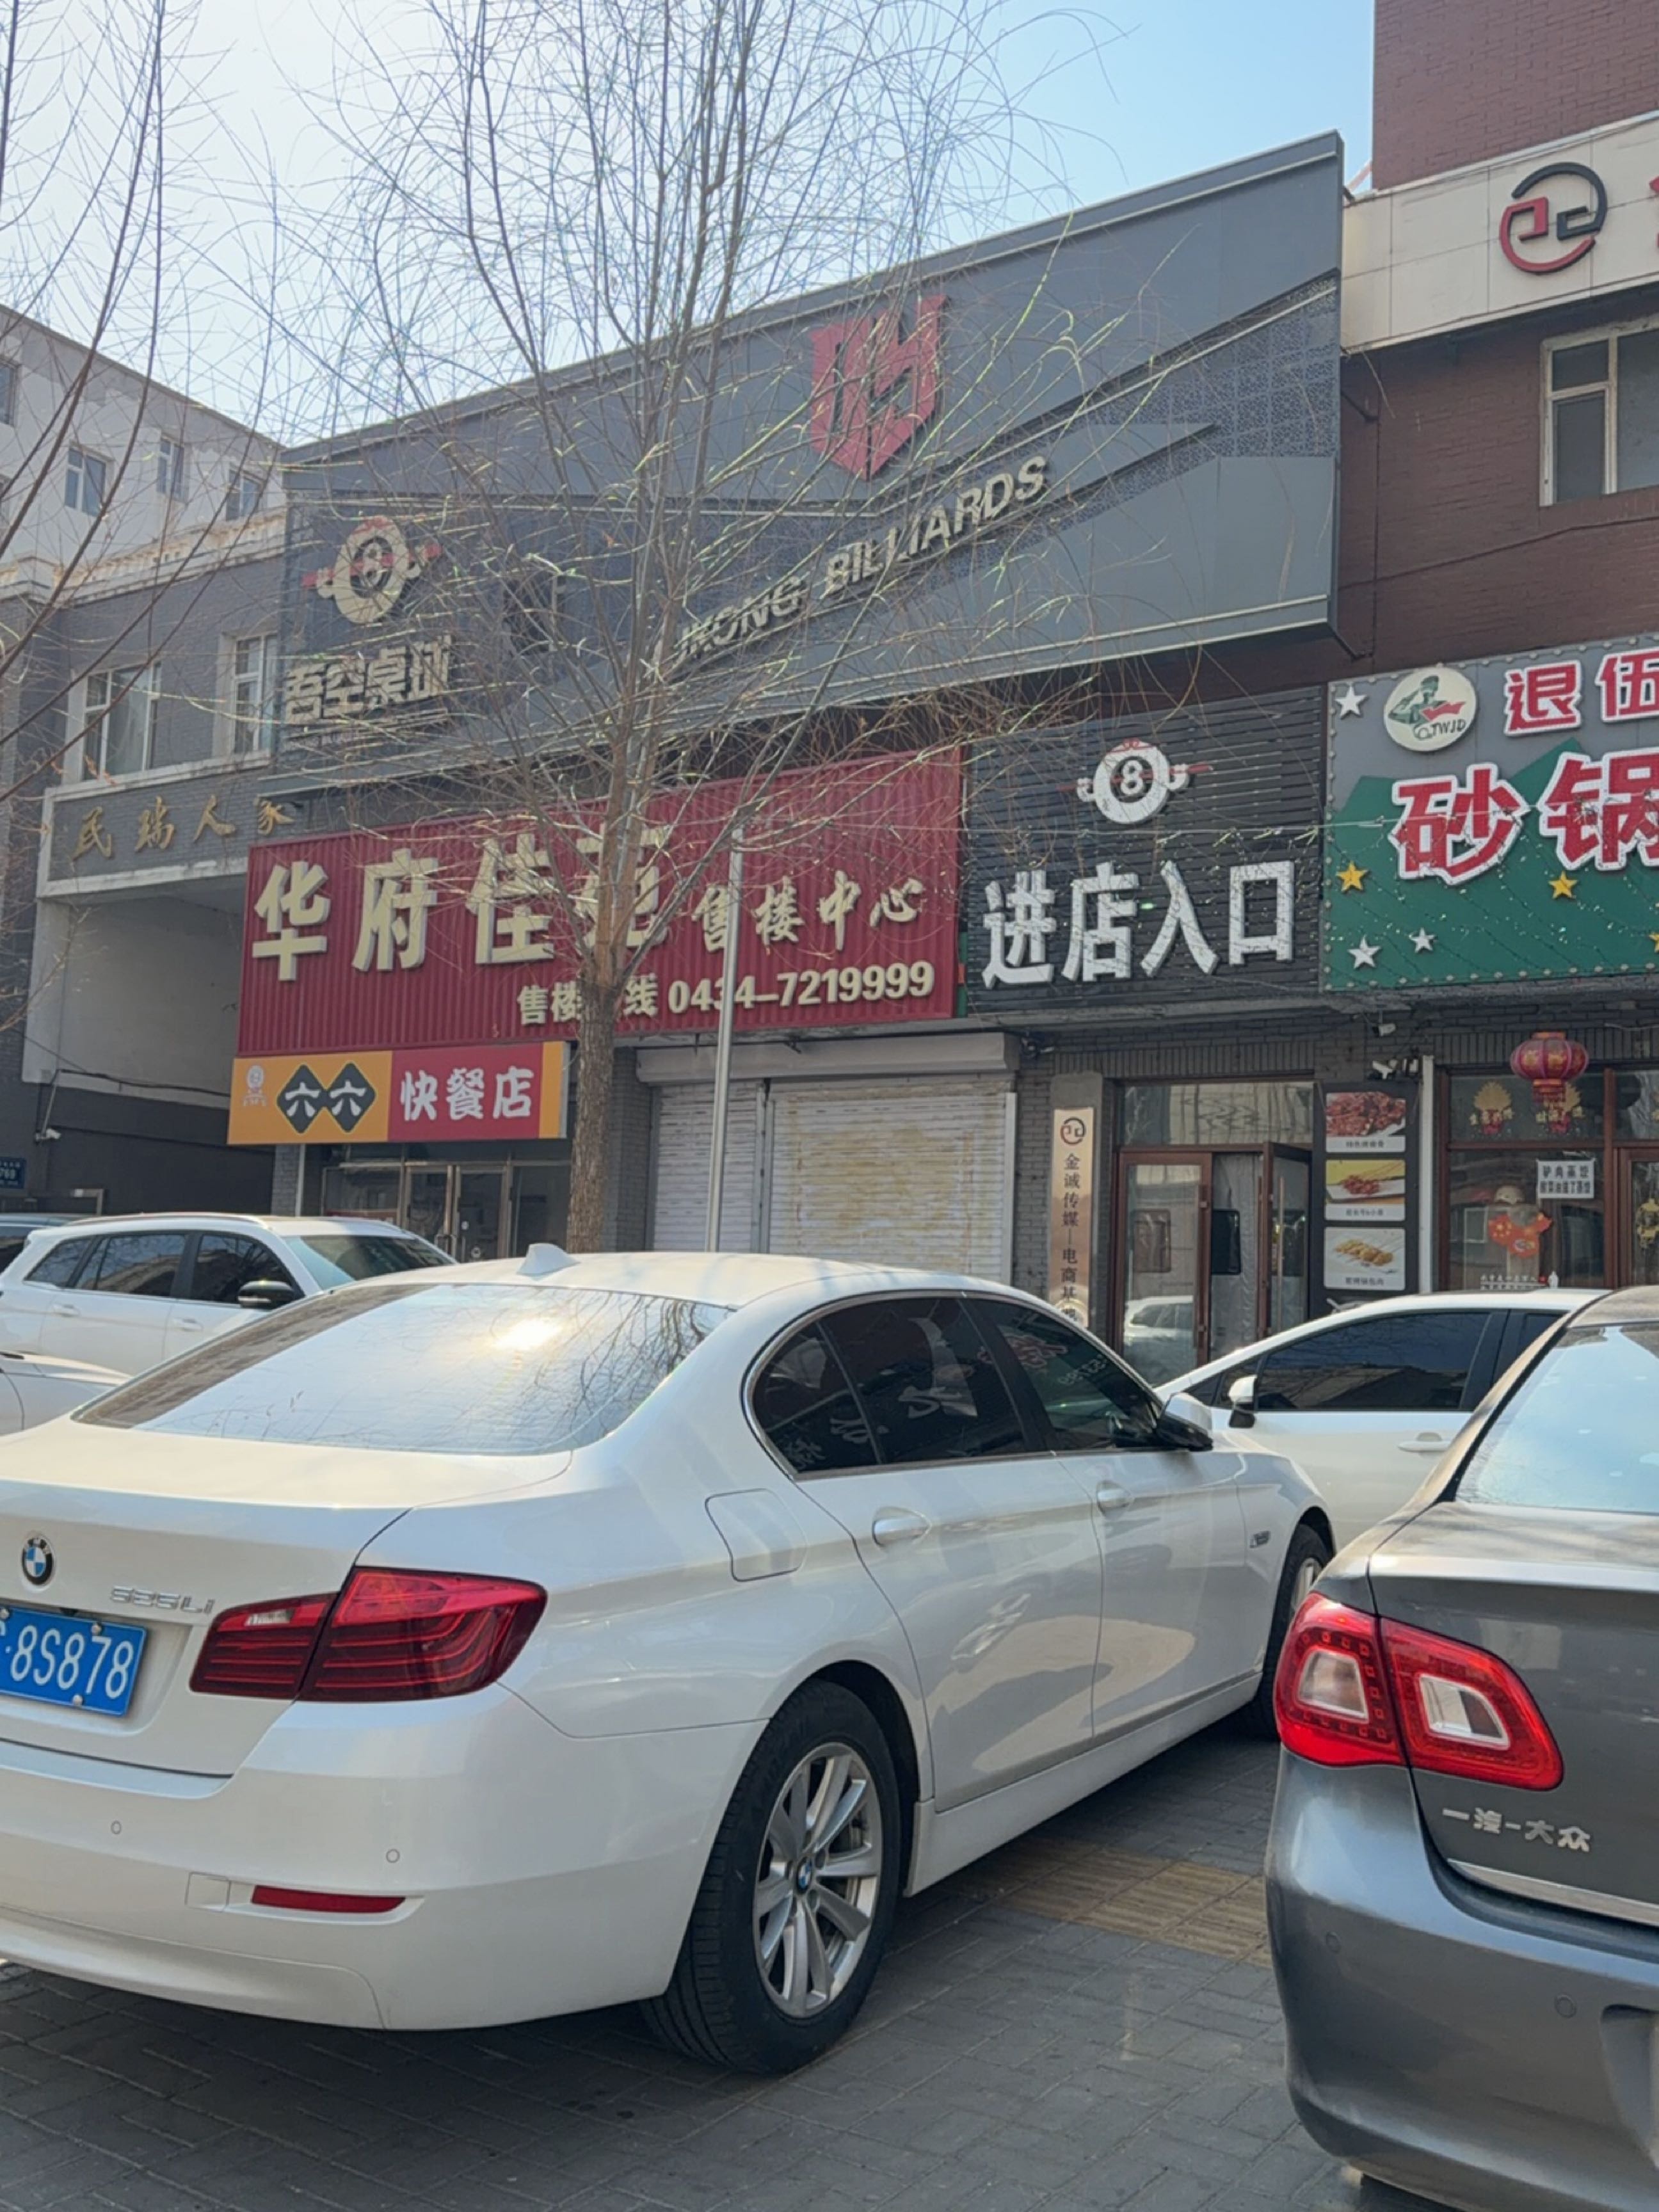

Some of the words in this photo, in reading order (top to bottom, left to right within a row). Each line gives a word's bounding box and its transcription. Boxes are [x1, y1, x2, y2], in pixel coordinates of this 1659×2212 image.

[824, 456, 1047, 593] BILLIARDS
[1504, 647, 1659, 735] 退伍
[1388, 746, 1659, 885] 砂锅
[691, 870, 925, 953] 售楼中心
[981, 860, 1295, 989] 进店入口
[517, 973, 658, 1026] 售楼线
[285, 1080, 366, 1118] 六六
[400, 1066, 535, 1121] 快餐店
[1442, 1807, 1591, 1852] 一汽-大众
